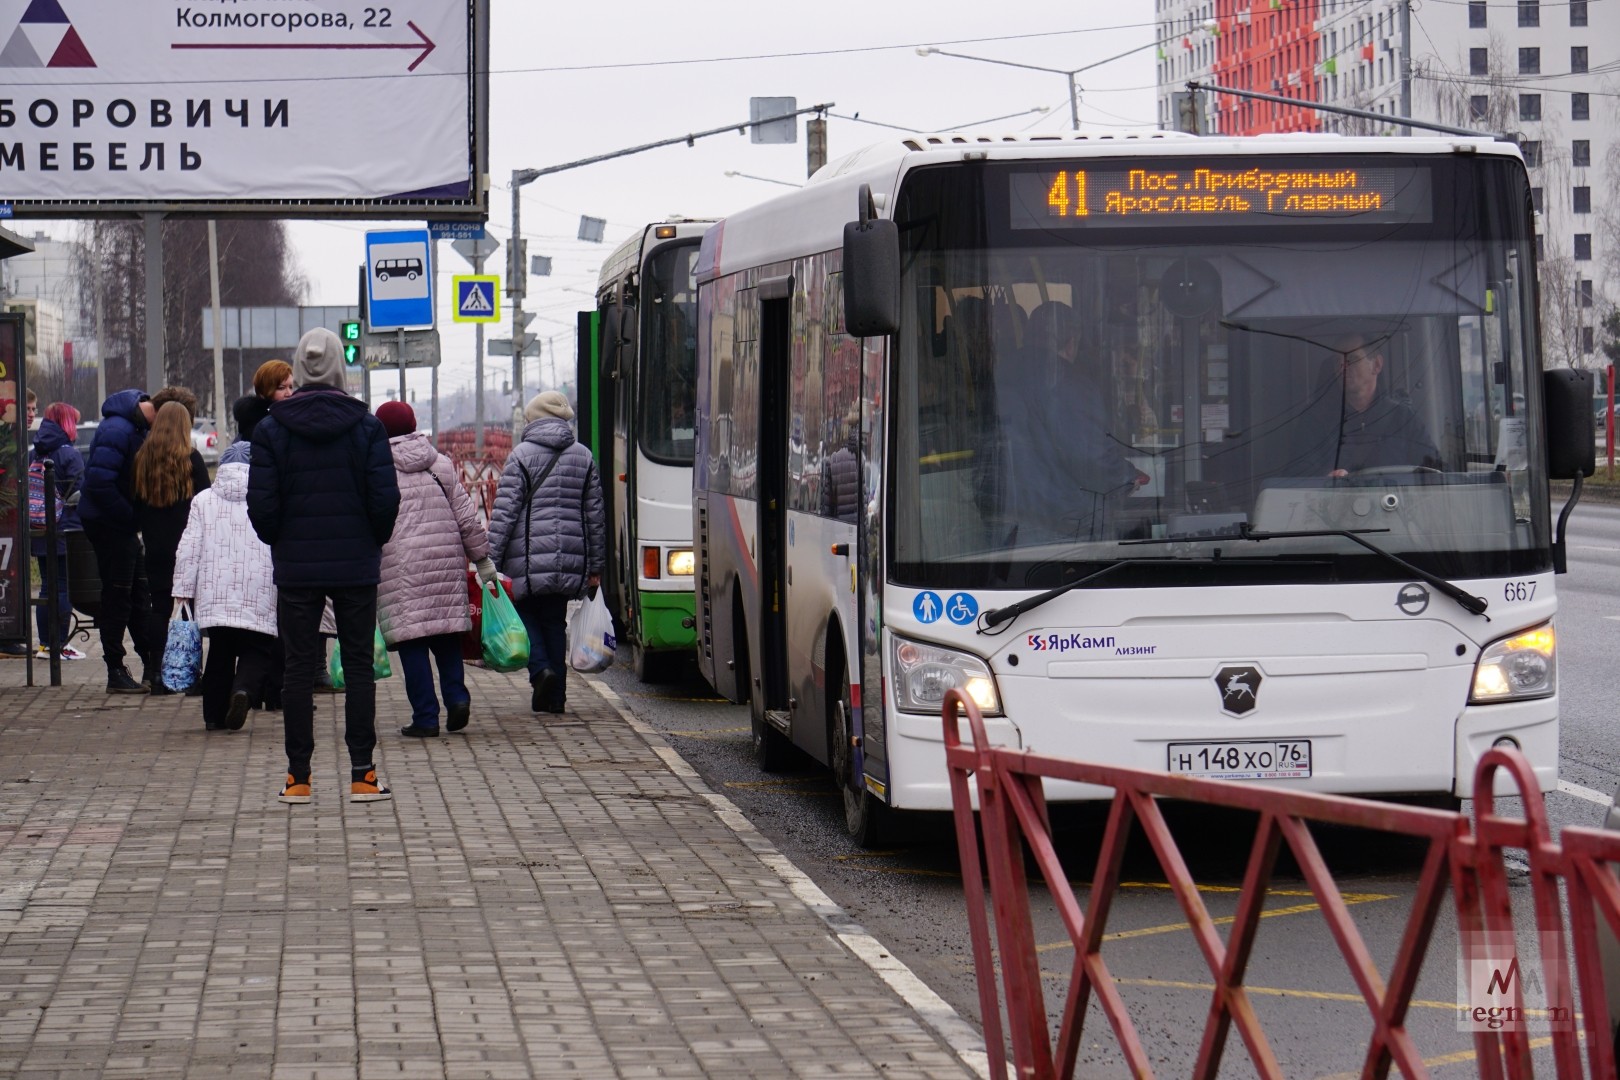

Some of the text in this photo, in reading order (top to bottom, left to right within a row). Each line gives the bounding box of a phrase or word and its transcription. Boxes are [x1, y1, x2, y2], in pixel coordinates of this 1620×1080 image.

[177, 8, 392, 32] Колмогорова, 22
[0, 98, 290, 128] БОРОВИЧИ
[0, 142, 202, 171] МЕБЕЛЬ
[1048, 168, 1356, 216] 41 Пос.Прибрежный
[1105, 189, 1381, 214] Ярославль Главный
[347, 323, 358, 339] 15
[1504, 581, 1537, 602] 667
[1048, 633, 1115, 652] ЯрКамп
[1115, 645, 1157, 655] лизинг
[1278, 744, 1301, 761] 76
[1278, 761, 1295, 769] RUS
